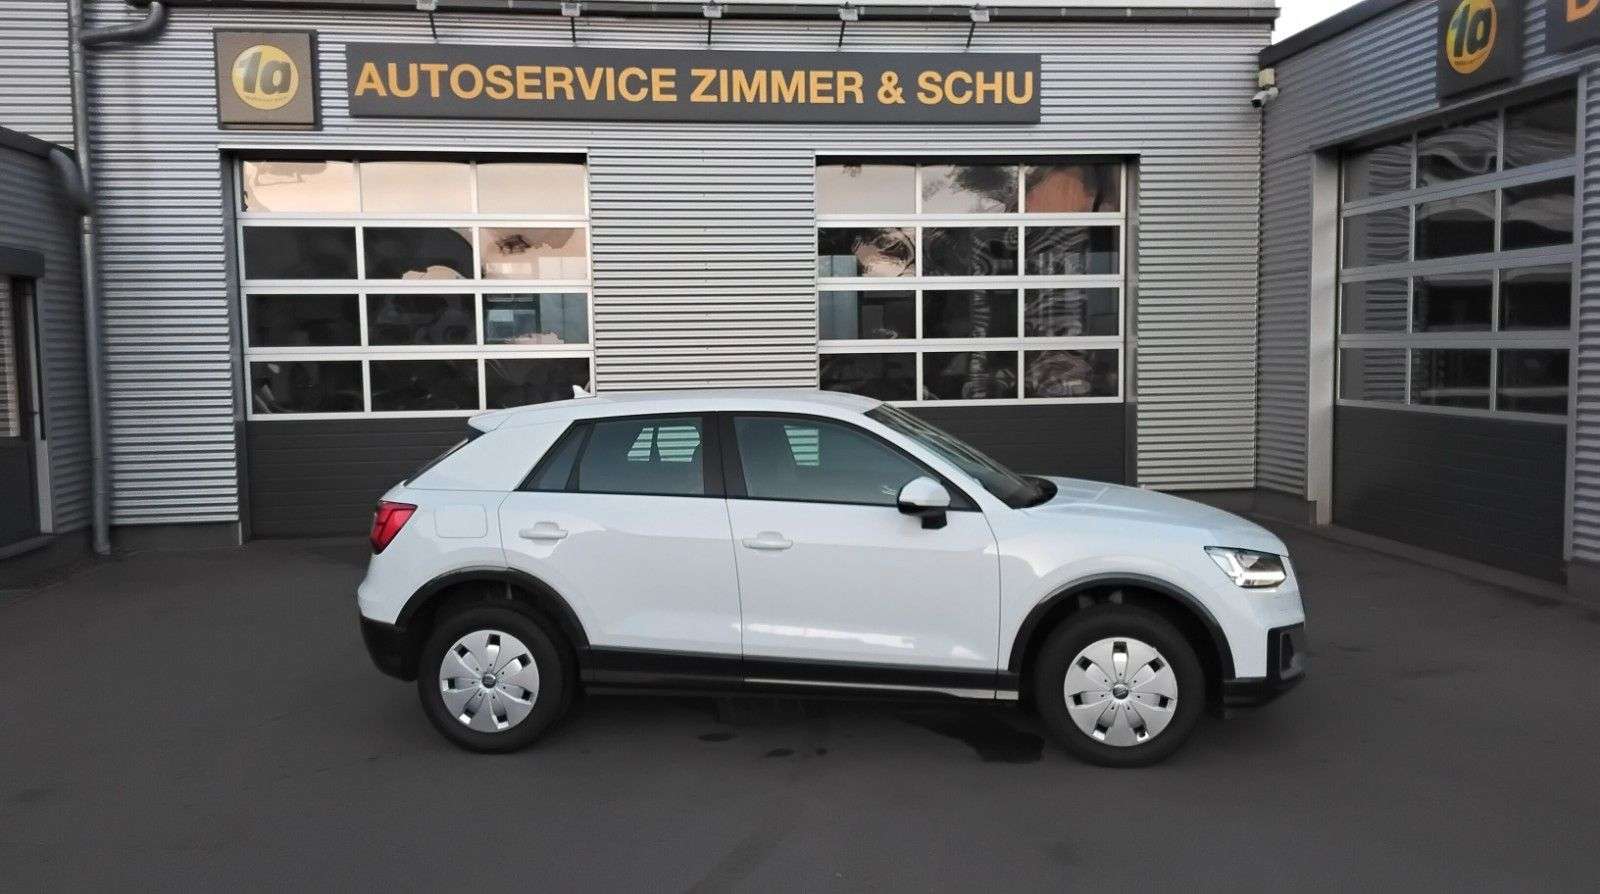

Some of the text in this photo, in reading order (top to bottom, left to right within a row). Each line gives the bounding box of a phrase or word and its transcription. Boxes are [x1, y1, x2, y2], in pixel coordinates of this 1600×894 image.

[239, 51, 291, 95] 1a
[354, 62, 1034, 105] AUTOSERVICE ZIMMER & SCHU
